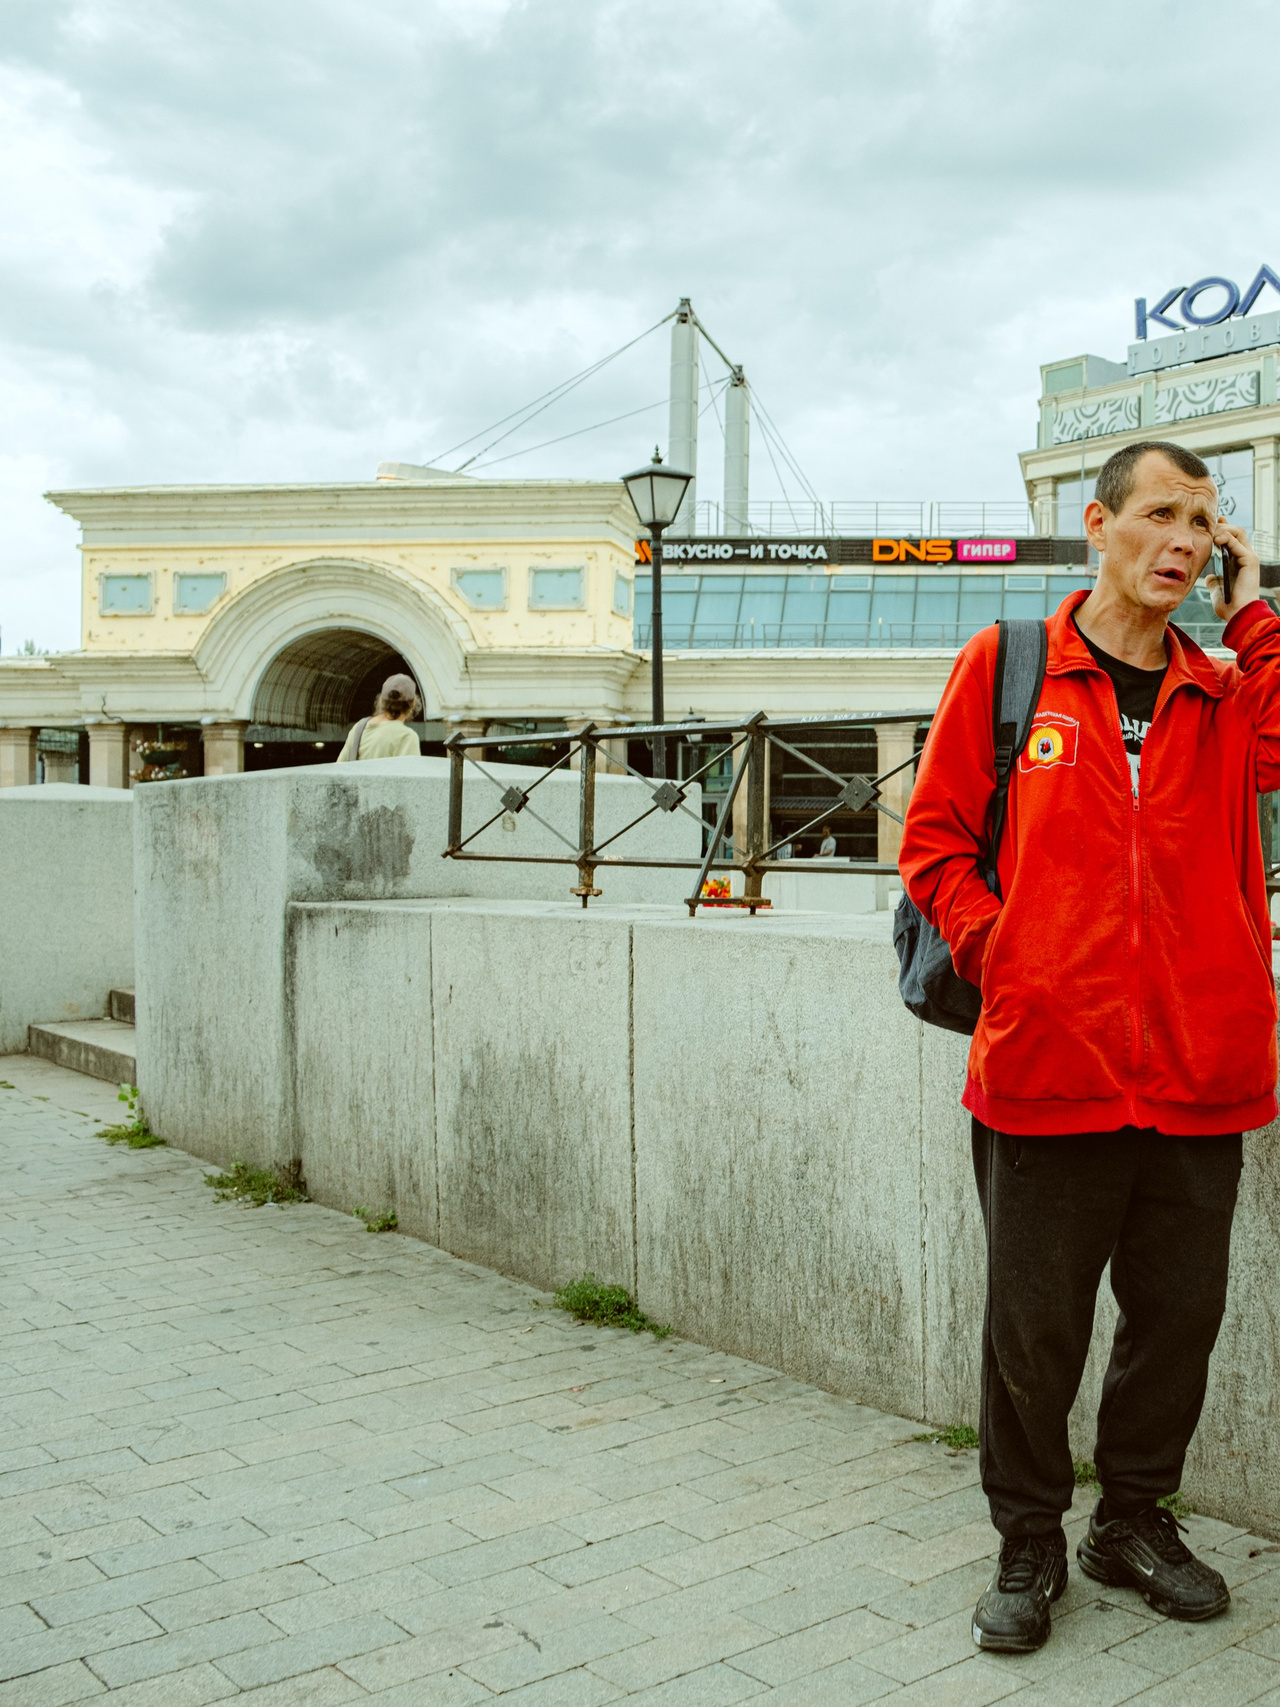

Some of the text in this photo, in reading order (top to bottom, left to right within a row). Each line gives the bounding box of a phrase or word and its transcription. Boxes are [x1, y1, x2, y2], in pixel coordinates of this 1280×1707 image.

[662, 544, 734, 559] ВКУСНО
[767, 544, 828, 560] ТОЧКА
[872, 539, 953, 562] DNS
[963, 544, 1011, 557] ГИПЕР
